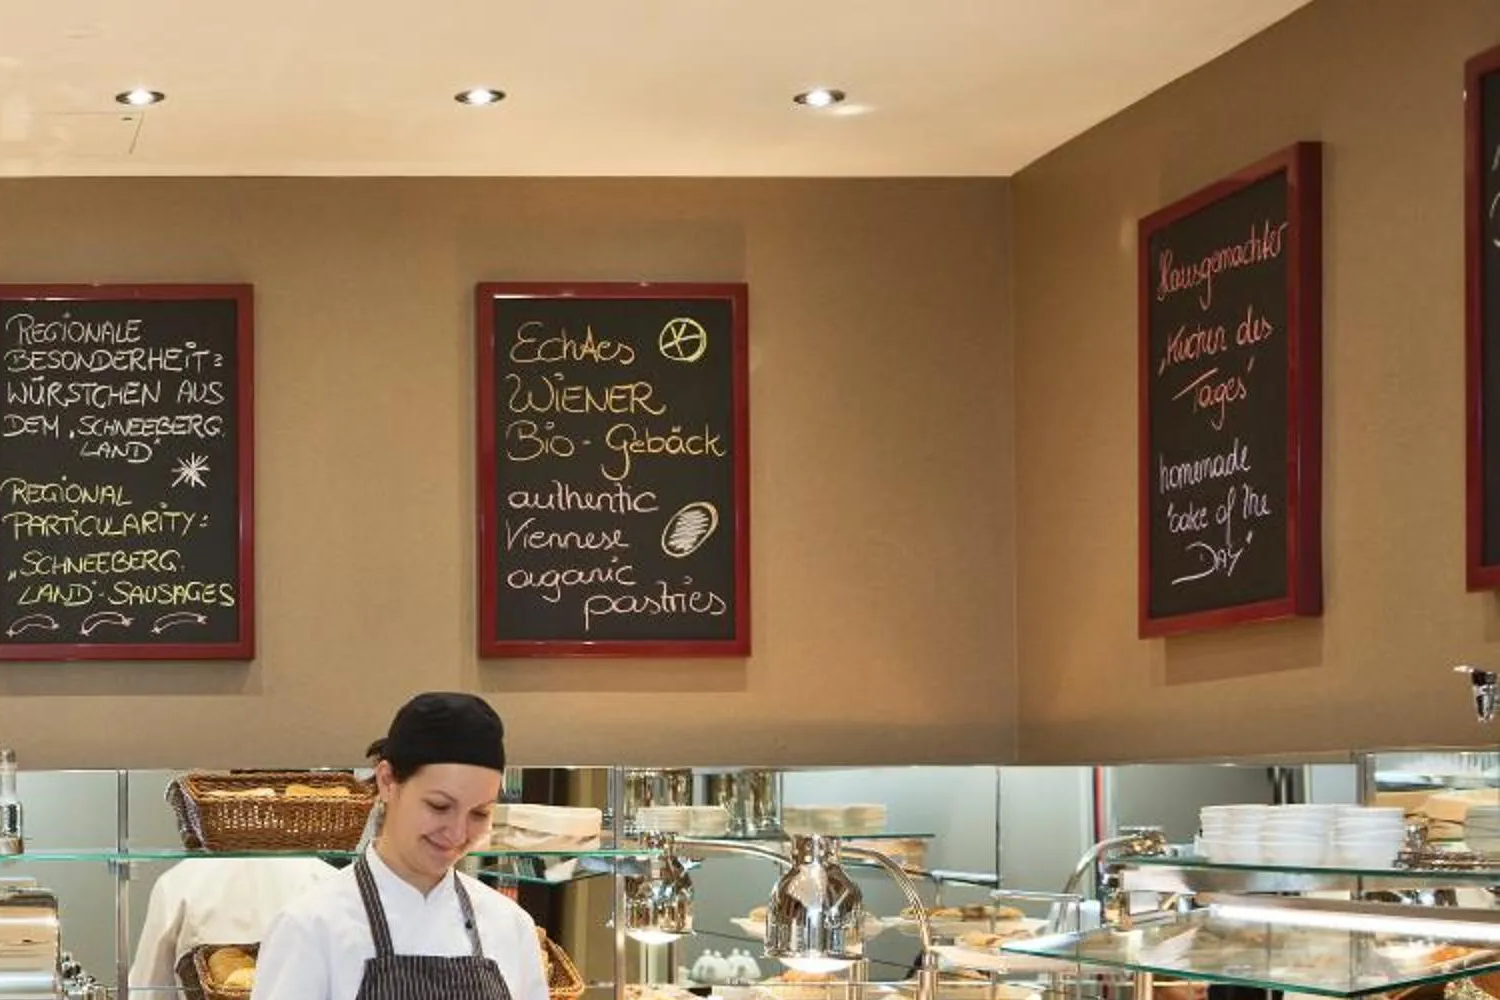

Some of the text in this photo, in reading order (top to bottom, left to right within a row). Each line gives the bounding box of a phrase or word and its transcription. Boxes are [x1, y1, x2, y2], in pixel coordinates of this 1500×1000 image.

[5, 312, 143, 345] REGIONALE
[509, 321, 636, 365] Echtes
[1236, 304, 1274, 346] des
[7, 376, 225, 409] WÜRSTCHEN AUS
[3, 414, 60, 439] DEM
[1159, 437, 1251, 494] homemade
[0, 475, 133, 506] REGIONAL
[507, 480, 660, 514] authentic
[506, 516, 630, 551] Viennese
[1216, 485, 1237, 548] of
[1242, 483, 1271, 519] the
[507, 556, 637, 603] organic
[583, 575, 727, 631] pastries
